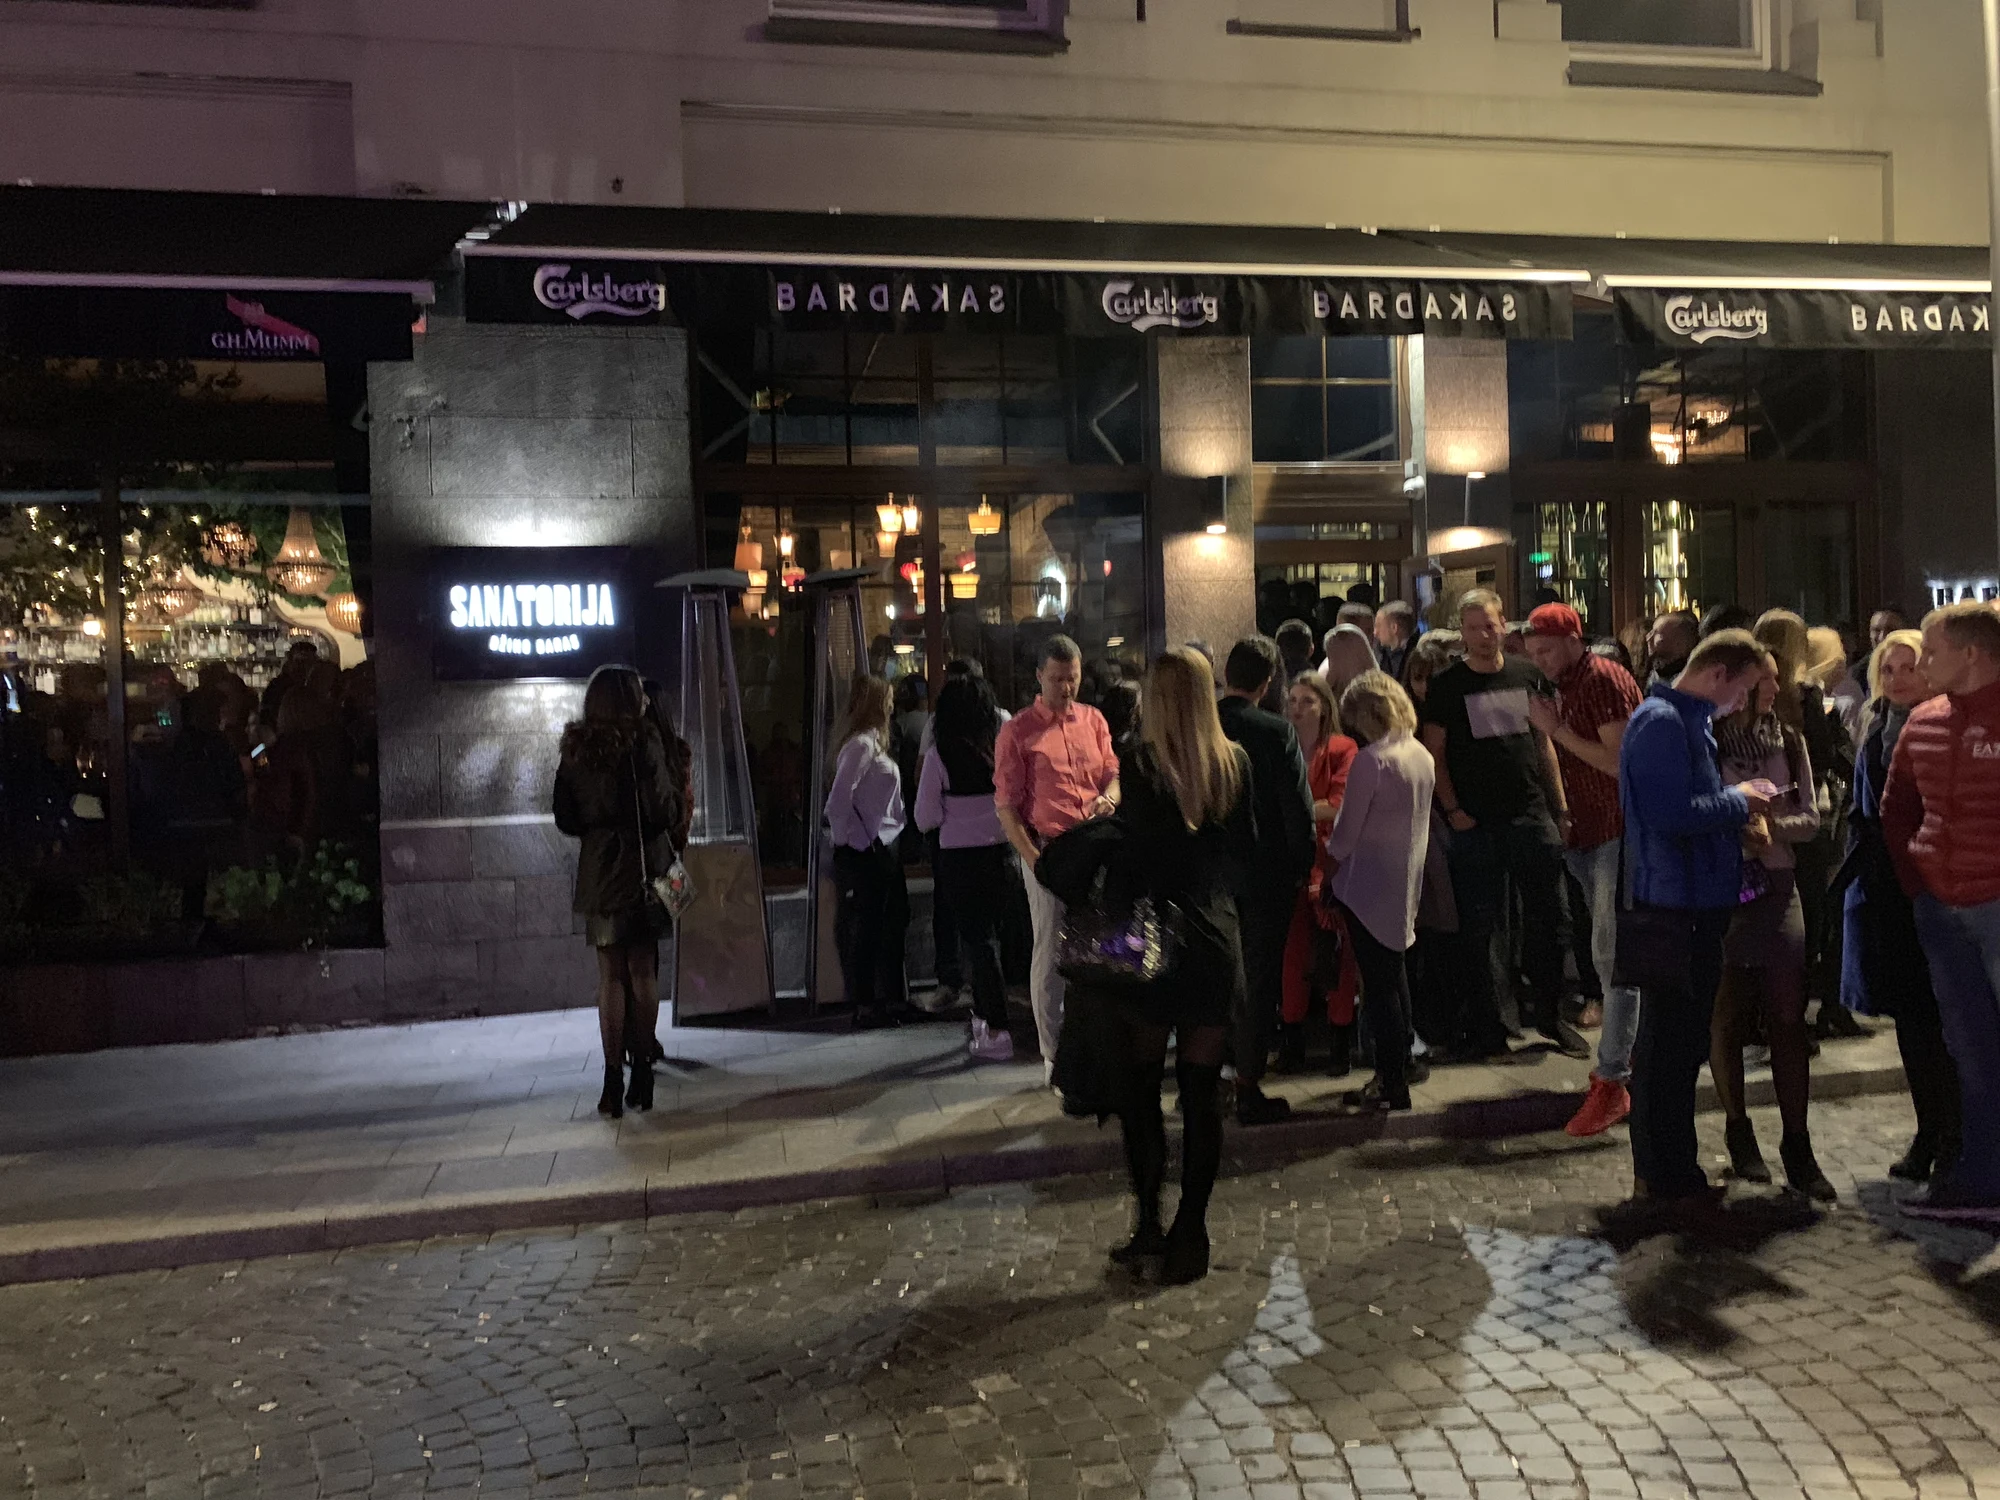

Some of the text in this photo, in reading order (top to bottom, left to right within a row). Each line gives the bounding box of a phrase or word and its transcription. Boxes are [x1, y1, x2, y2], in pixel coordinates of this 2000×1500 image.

[533, 264, 666, 319] Carlsberg
[1102, 280, 1219, 333] Carlsberg
[1664, 295, 1768, 344] Carlsberg
[450, 584, 615, 627] SANATORIJA
